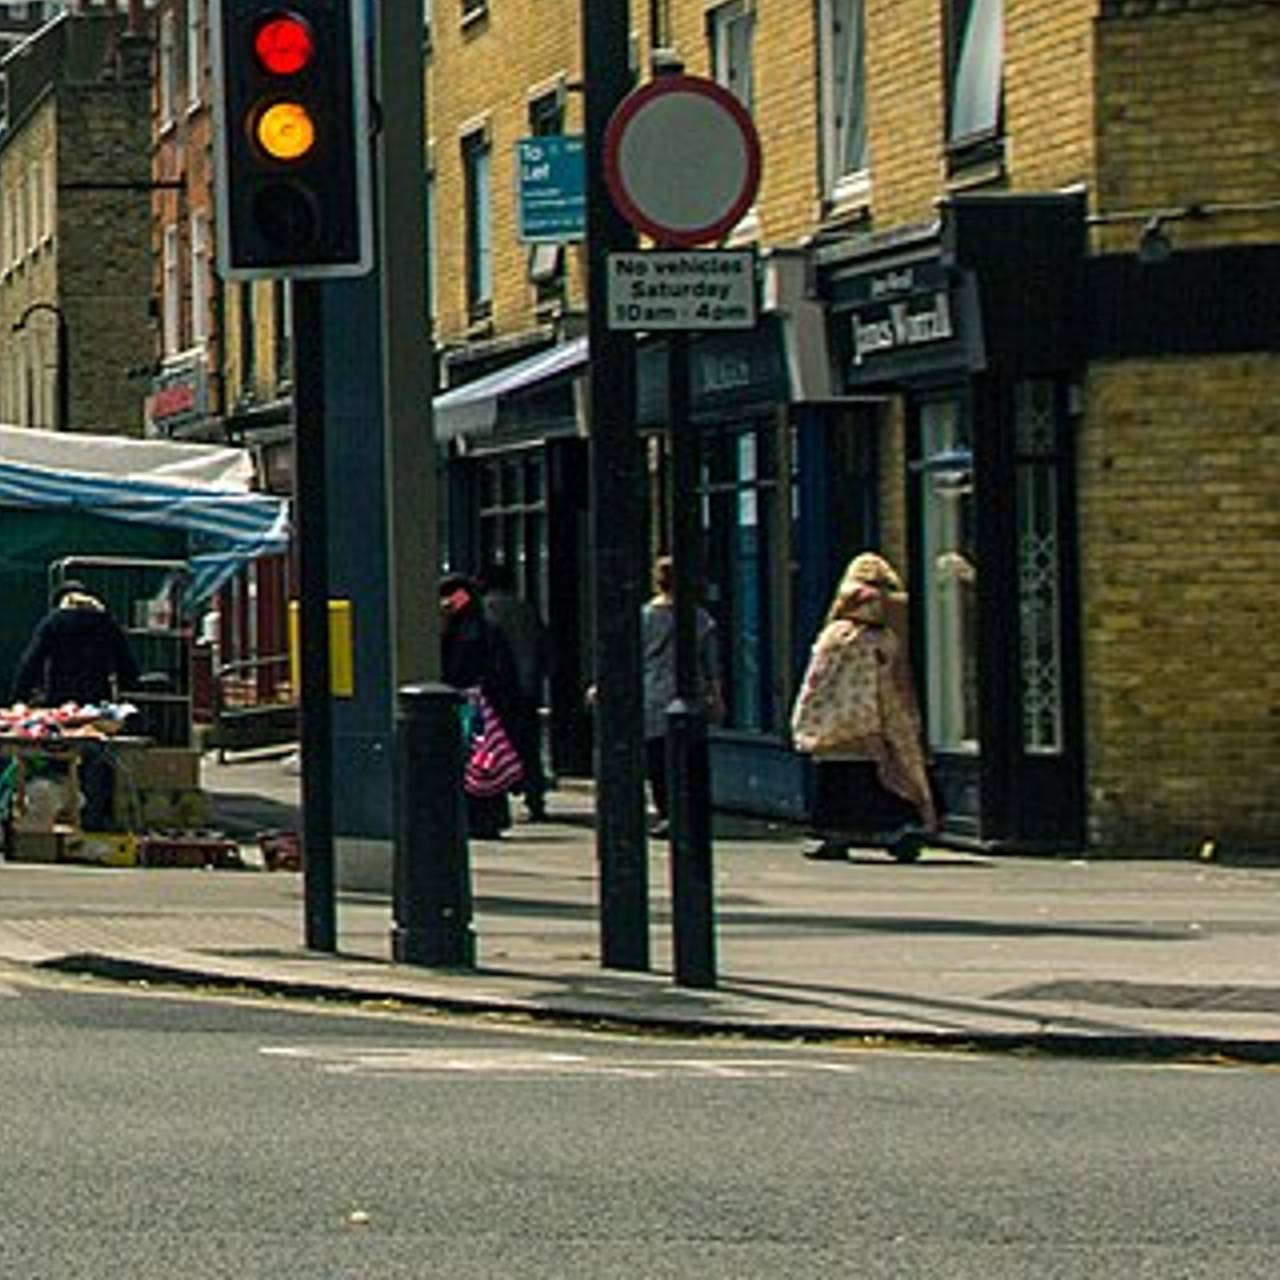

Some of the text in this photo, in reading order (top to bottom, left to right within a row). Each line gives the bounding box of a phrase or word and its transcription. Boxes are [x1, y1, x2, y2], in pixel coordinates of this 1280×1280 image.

[616, 259, 742, 275] No vehicles
[631, 281, 731, 300] Saturday
[695, 304, 747, 322] 4pm
